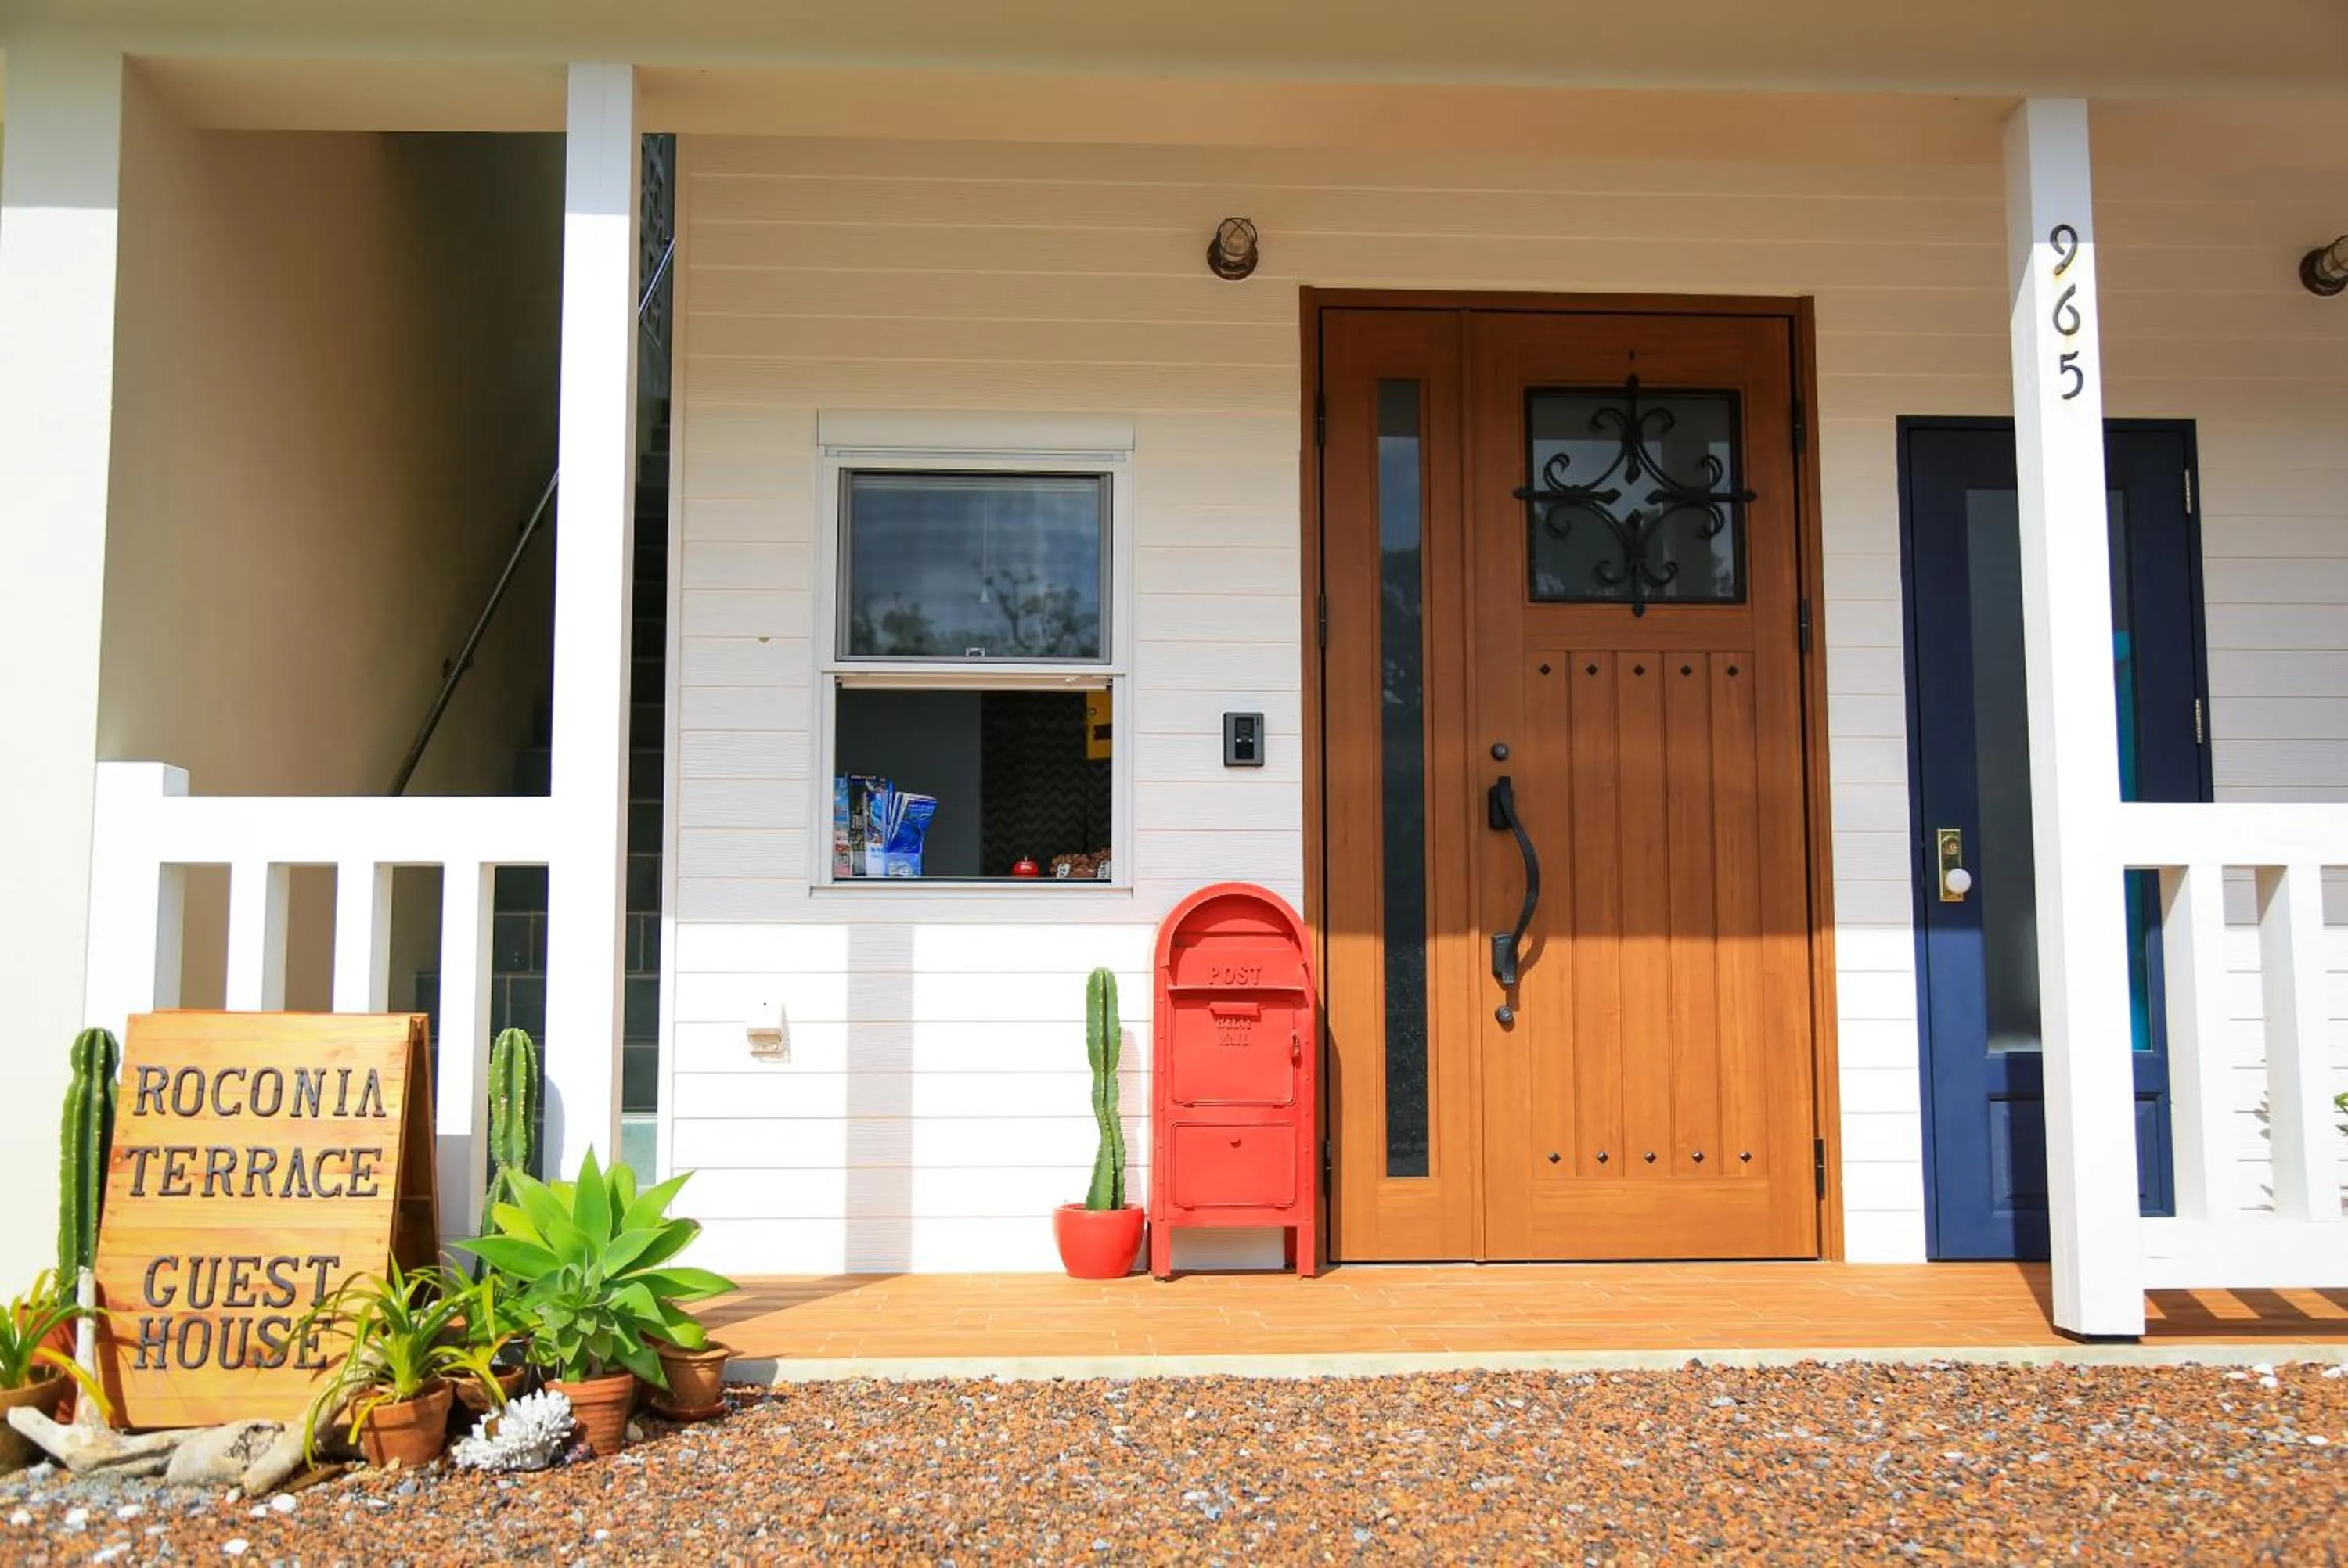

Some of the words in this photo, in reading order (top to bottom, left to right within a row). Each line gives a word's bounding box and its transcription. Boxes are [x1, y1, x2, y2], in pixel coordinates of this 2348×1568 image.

[2050, 224, 2083, 400] 965
[1209, 965, 1262, 985] POST
[132, 1065, 387, 1117] ROCONIA
[124, 1145, 383, 1198] TERRACE
[142, 1255, 340, 1309] GUEST
[132, 1315, 332, 1369] HOUSE
